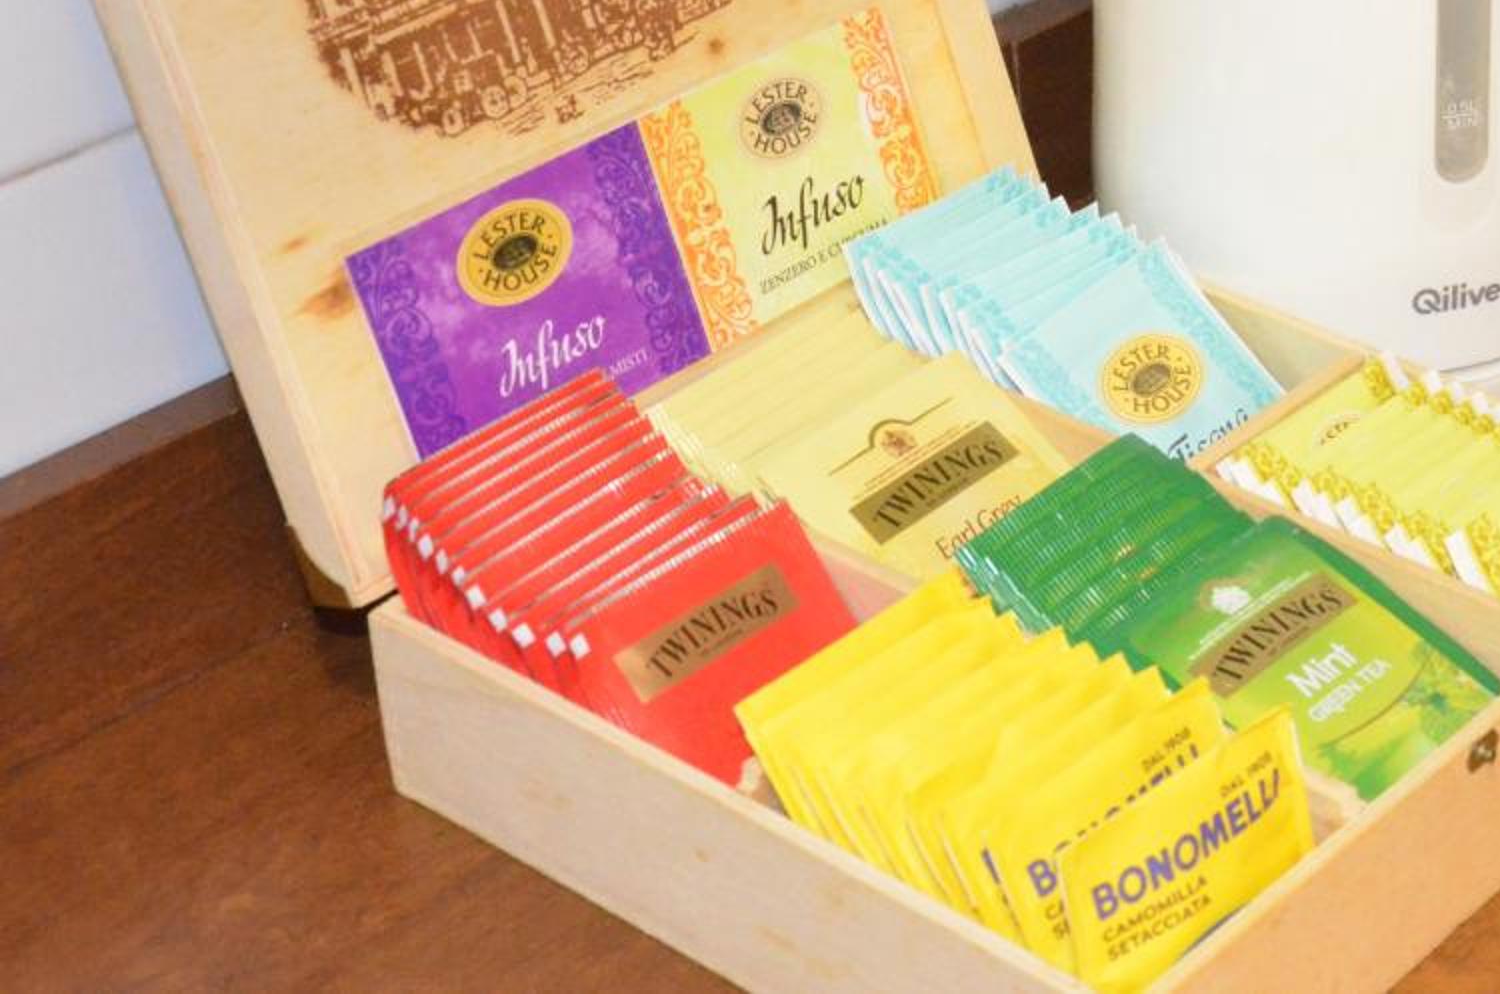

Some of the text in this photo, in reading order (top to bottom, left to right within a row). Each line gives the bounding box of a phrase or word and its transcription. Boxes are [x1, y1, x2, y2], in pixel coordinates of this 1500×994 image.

[746, 81, 817, 154] LESTER HOUSE
[474, 211, 557, 291] LESTER HOUSE
[761, 174, 864, 255] Infuso
[500, 315, 606, 397] Infuso
[1114, 344, 1191, 414] LESTER HOUSE
[873, 440, 1003, 527] TWININGS
[646, 588, 779, 678] TWININGS
[1212, 589, 1343, 680] TWININGS
[1285, 642, 1358, 698] Mint
[1091, 768, 1280, 921] BONOMELLI
[1103, 875, 1208, 943] CAMOMILLA
[1107, 894, 1211, 962] SETACCIATA
